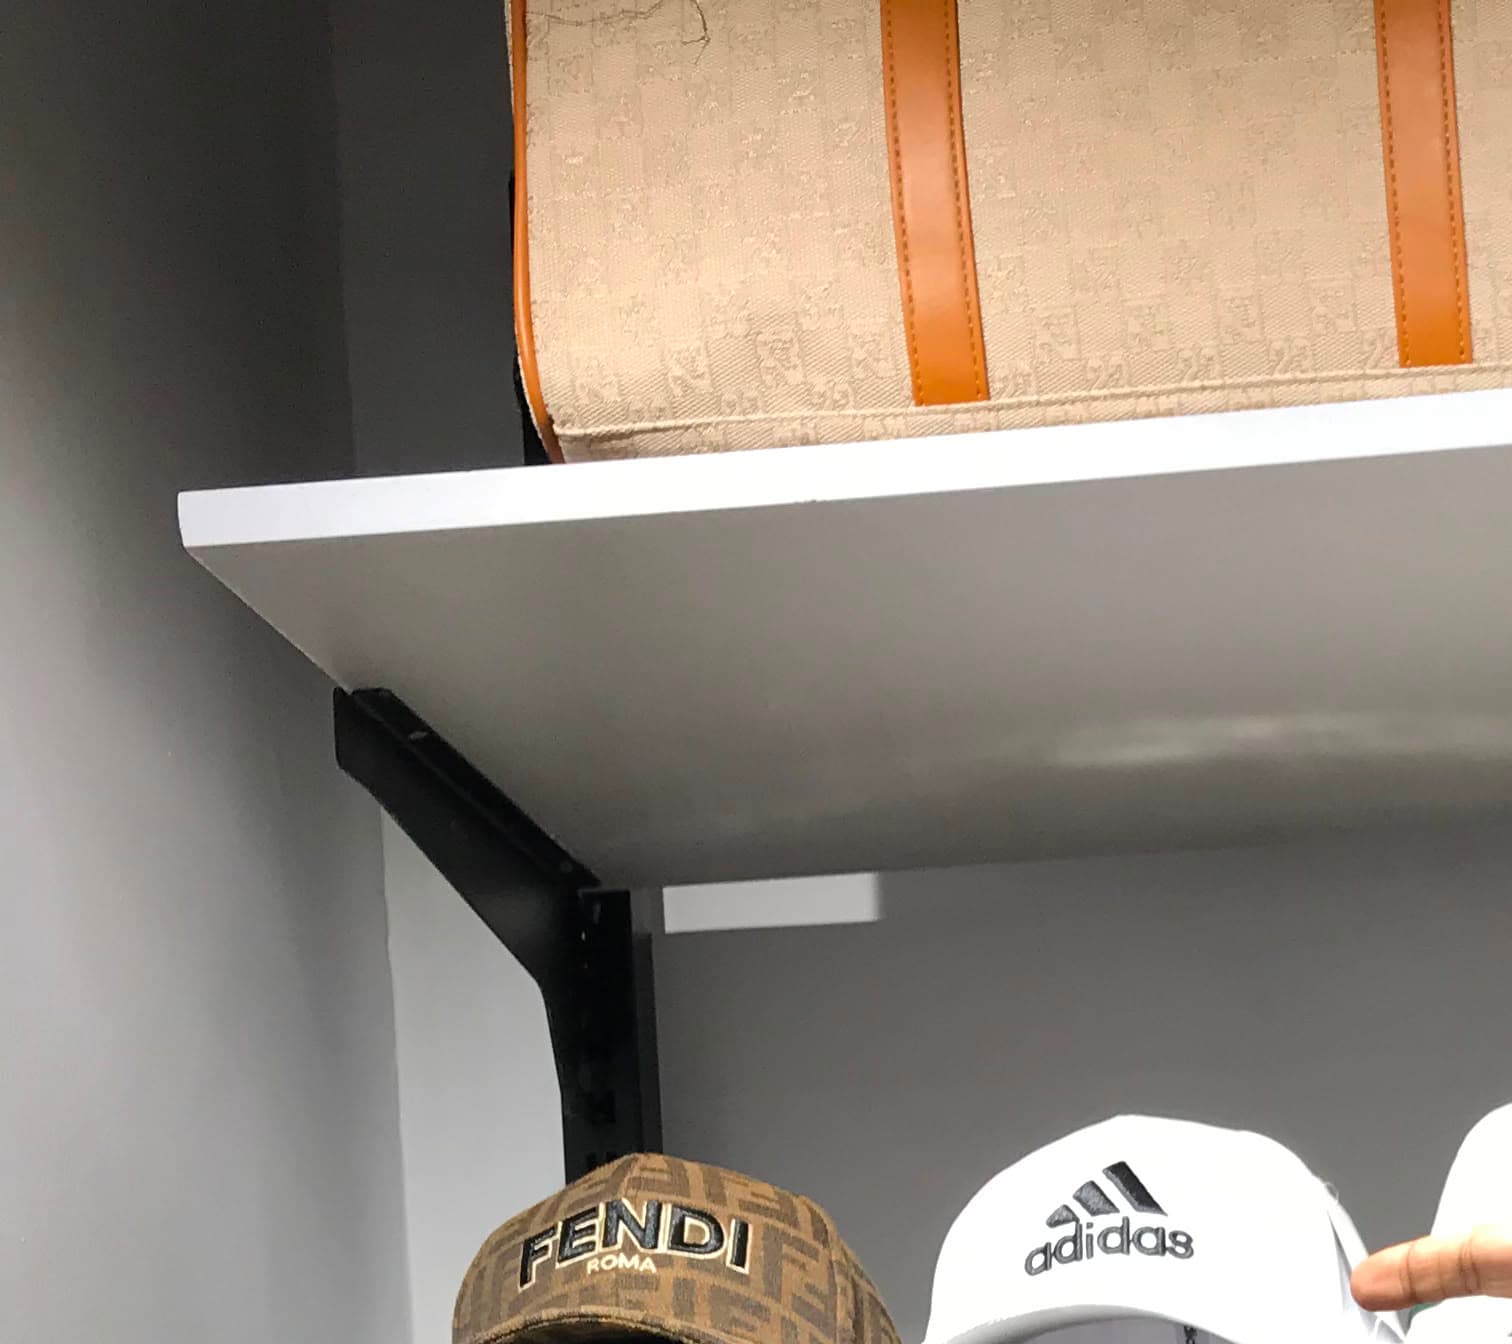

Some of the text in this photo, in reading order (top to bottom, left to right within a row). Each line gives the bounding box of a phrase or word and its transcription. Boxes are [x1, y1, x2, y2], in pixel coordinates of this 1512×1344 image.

[518, 1198, 752, 1292] FENDI
[586, 1253, 658, 1275] ROMA
[1024, 1216, 1194, 1276] adidas
